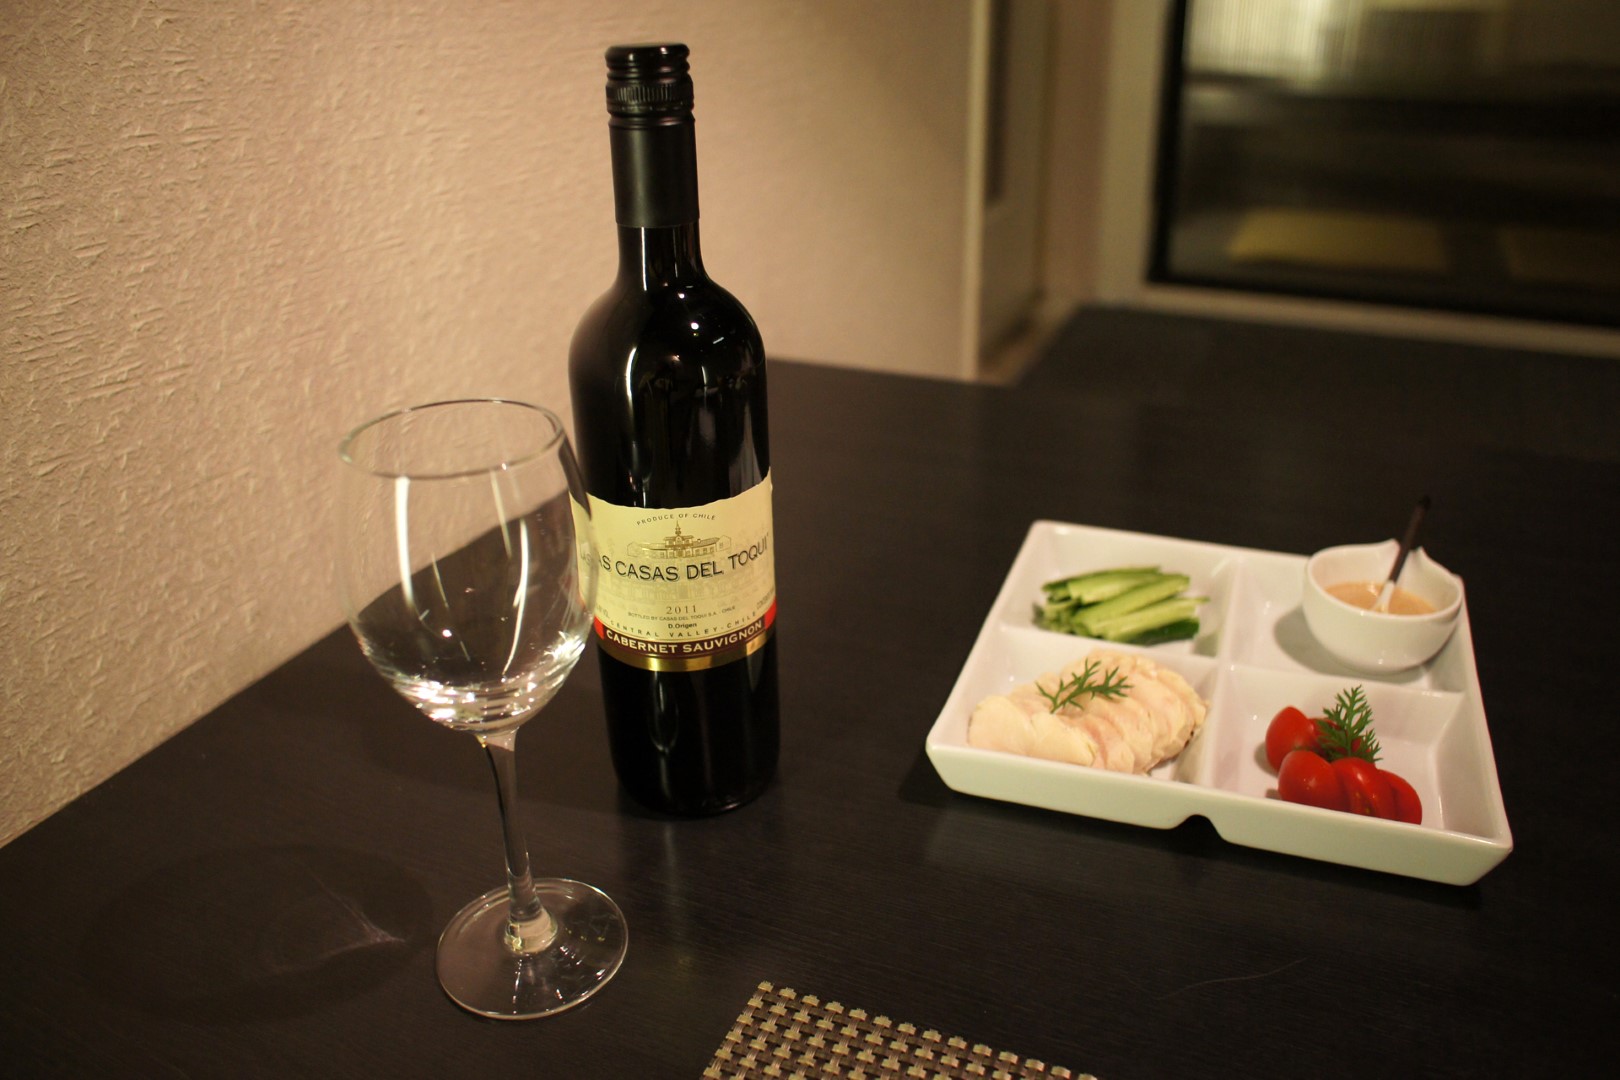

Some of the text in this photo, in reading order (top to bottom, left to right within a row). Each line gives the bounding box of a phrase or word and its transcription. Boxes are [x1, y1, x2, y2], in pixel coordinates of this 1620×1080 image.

[636, 513, 674, 526] PRODUCE
[692, 513, 717, 521] CHILE
[615, 560, 680, 582] CASAS
[686, 560, 724, 580] DEL
[727, 536, 768, 570] TOQUI
[627, 611, 651, 620] BOTTLED
[665, 604, 697, 615] 2011
[610, 620, 660, 637] CENTRAL
[605, 619, 763, 654] CABERNET SAUVIGNON
